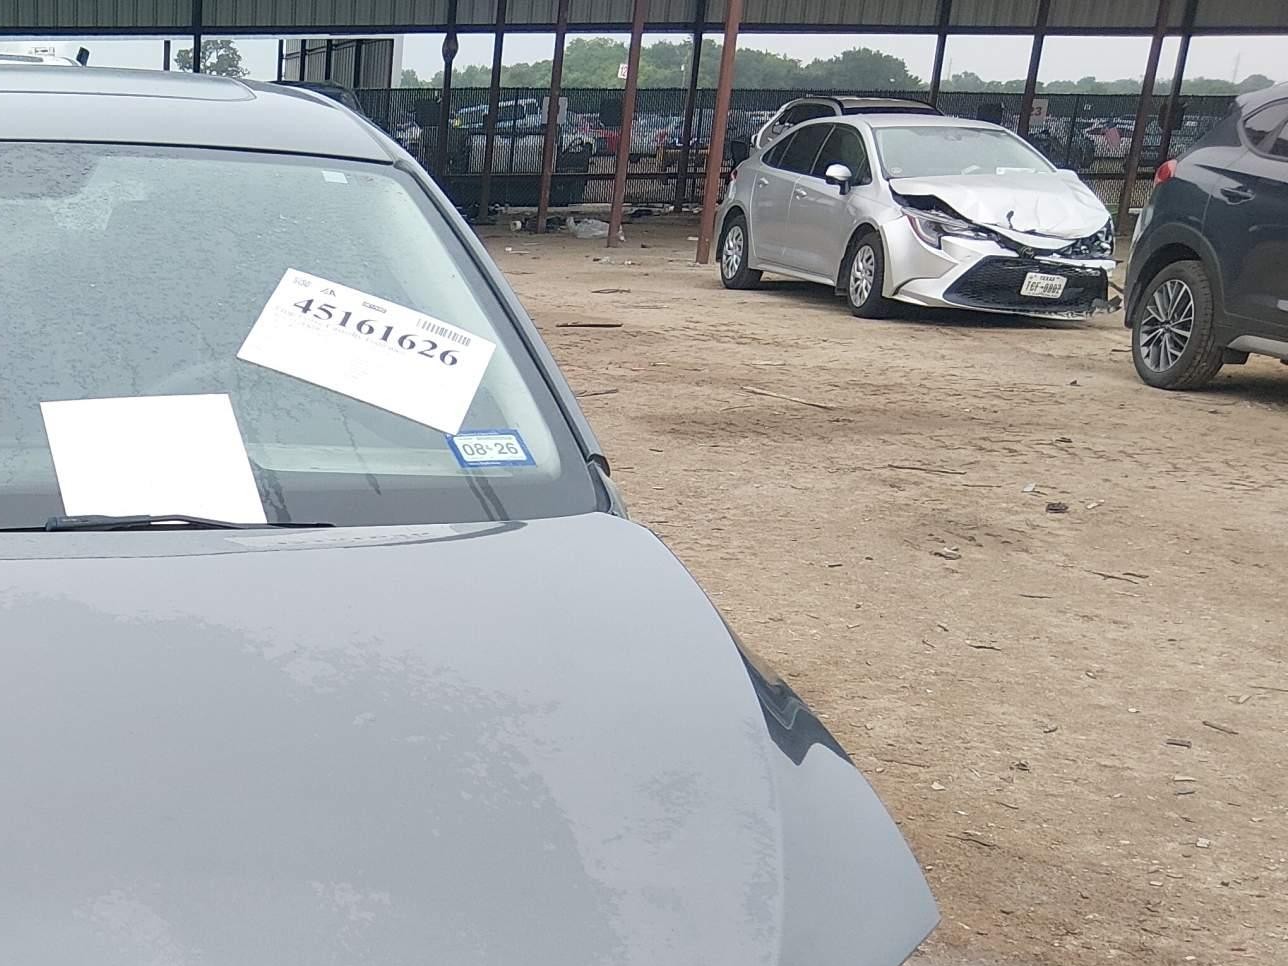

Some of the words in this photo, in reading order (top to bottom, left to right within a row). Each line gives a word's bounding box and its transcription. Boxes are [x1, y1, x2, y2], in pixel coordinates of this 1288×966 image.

[293, 298, 461, 367] 45161626
[462, 443, 488, 456] 08
[494, 442, 519, 455] 26
